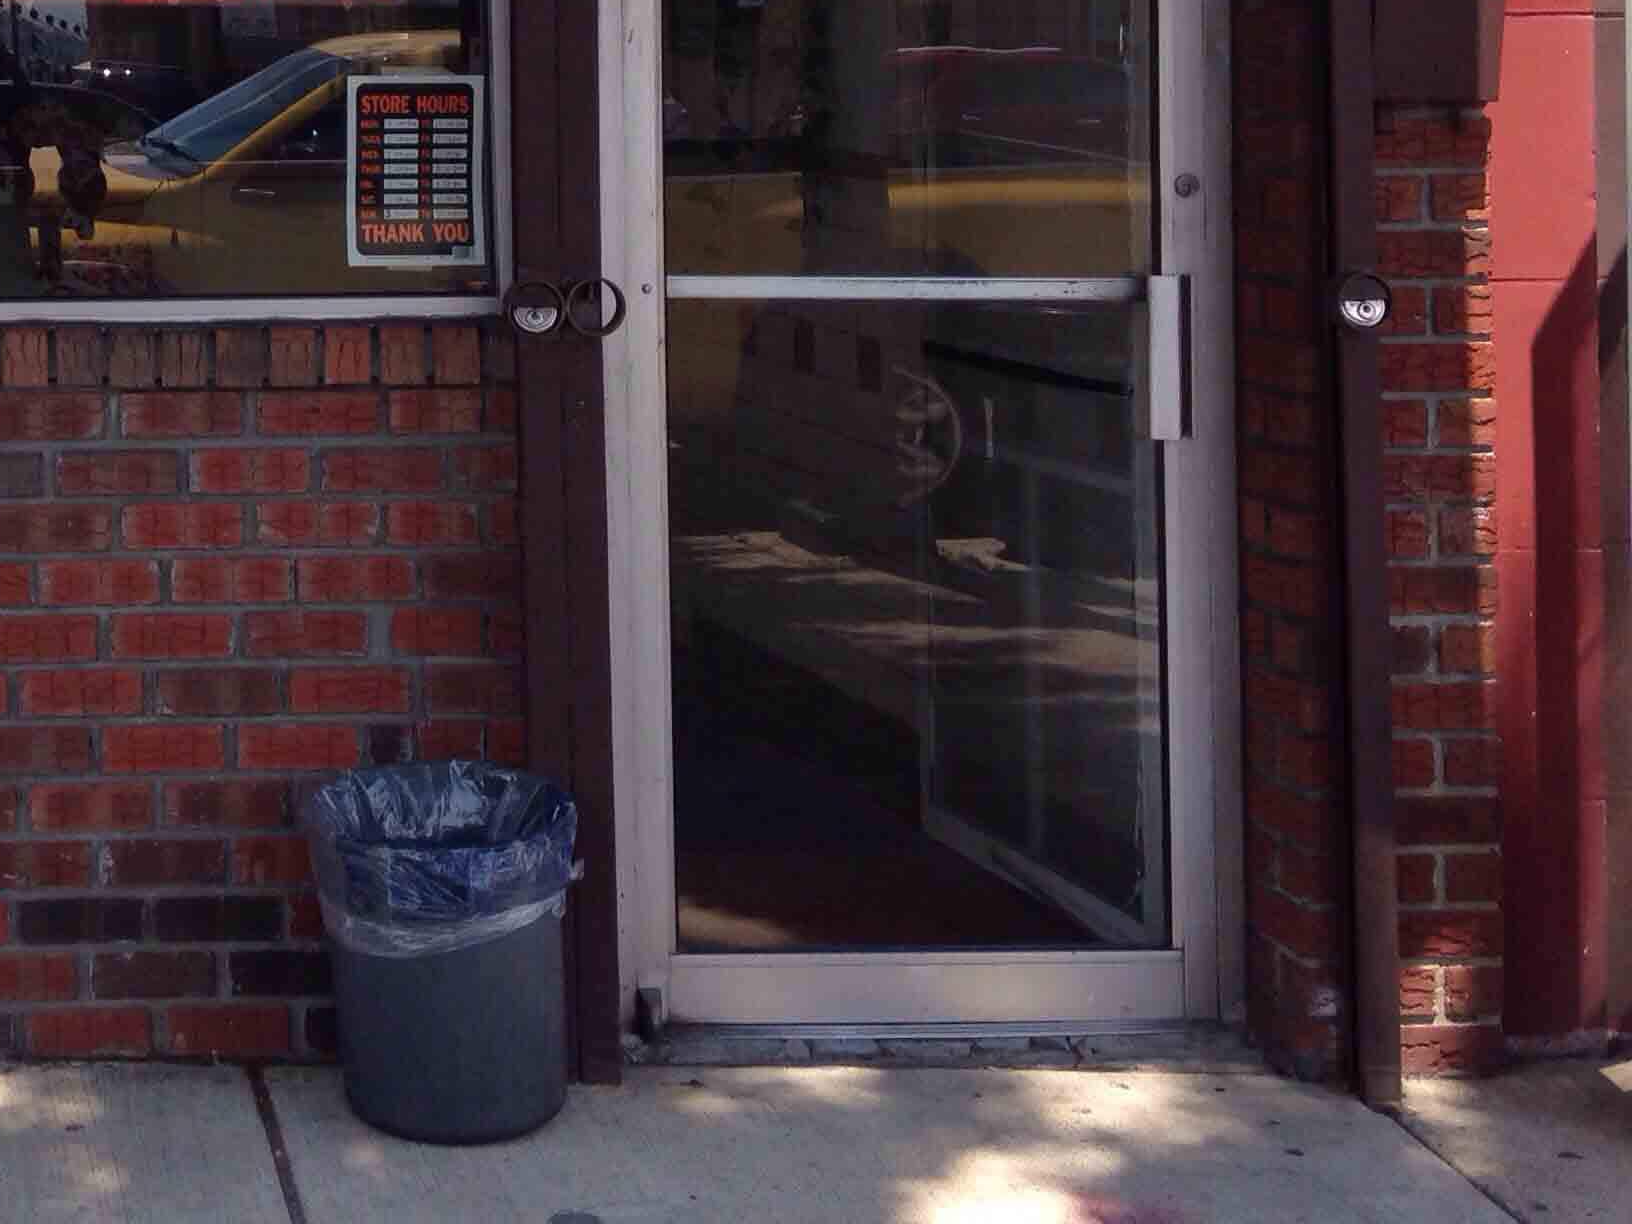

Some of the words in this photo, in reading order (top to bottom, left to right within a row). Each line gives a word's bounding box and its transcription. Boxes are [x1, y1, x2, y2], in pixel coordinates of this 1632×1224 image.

[360, 94, 411, 114] STORE
[416, 94, 470, 114] HOURS
[360, 223, 426, 243] THANK
[431, 223, 470, 243] YOU
